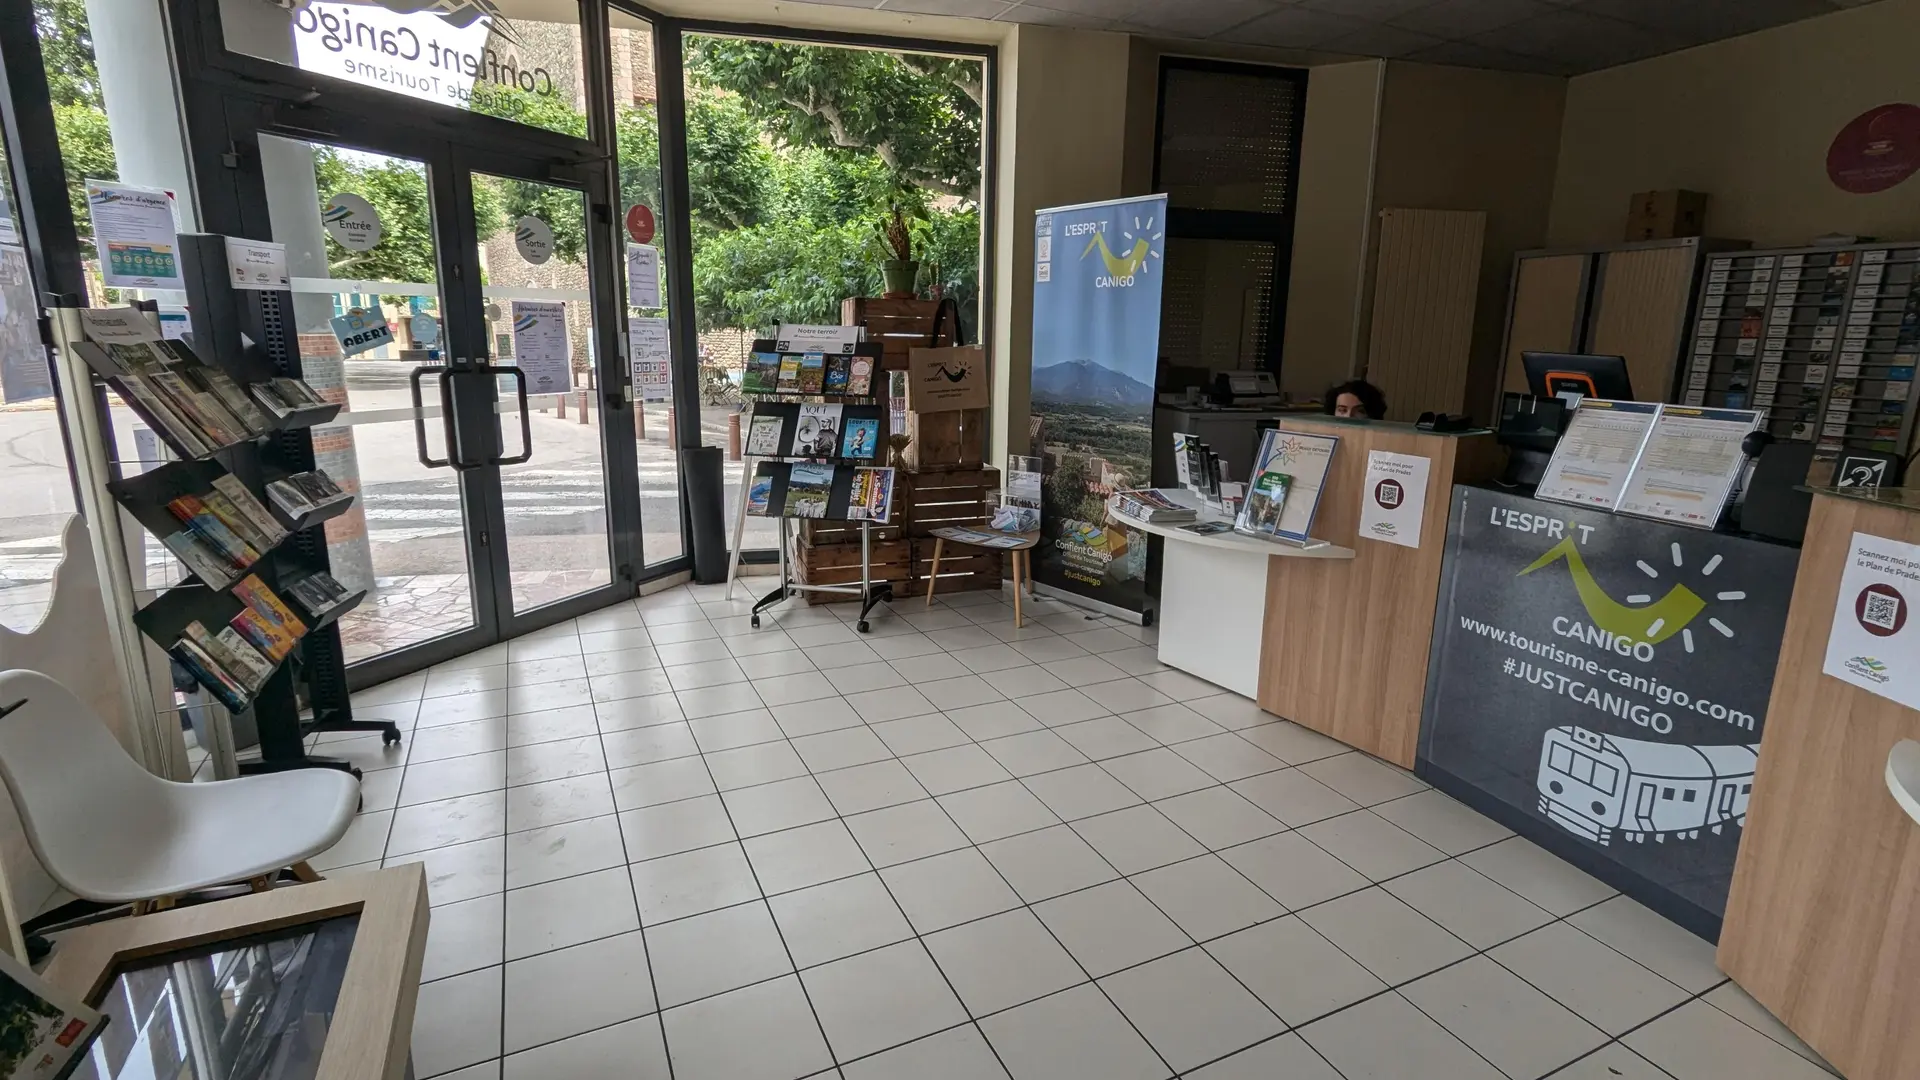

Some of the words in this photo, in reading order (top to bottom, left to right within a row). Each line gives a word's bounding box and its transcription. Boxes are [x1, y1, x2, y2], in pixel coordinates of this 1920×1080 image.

[339, 220, 372, 231] Entrée
[525, 239, 546, 249] Sortie
[247, 249, 271, 259] Transport
[343, 326, 388, 348] OBERT
[1055, 539, 1087, 555] Conflent
[1857, 547, 1890, 561] Scannez
[1890, 557, 1908, 566] moi
[1908, 561, 1920, 570] po
[1857, 558, 1865, 567] le
[1865, 561, 1883, 571] Plan
[1884, 565, 1895, 575] de
[1064, 569, 1101, 586] #justcanigo
[1552, 616, 1655, 663] CANIGO
[1460, 615, 1756, 732] www.tourisme-canigo.com
[1503, 657, 1674, 735] #JUSTCANIGO
